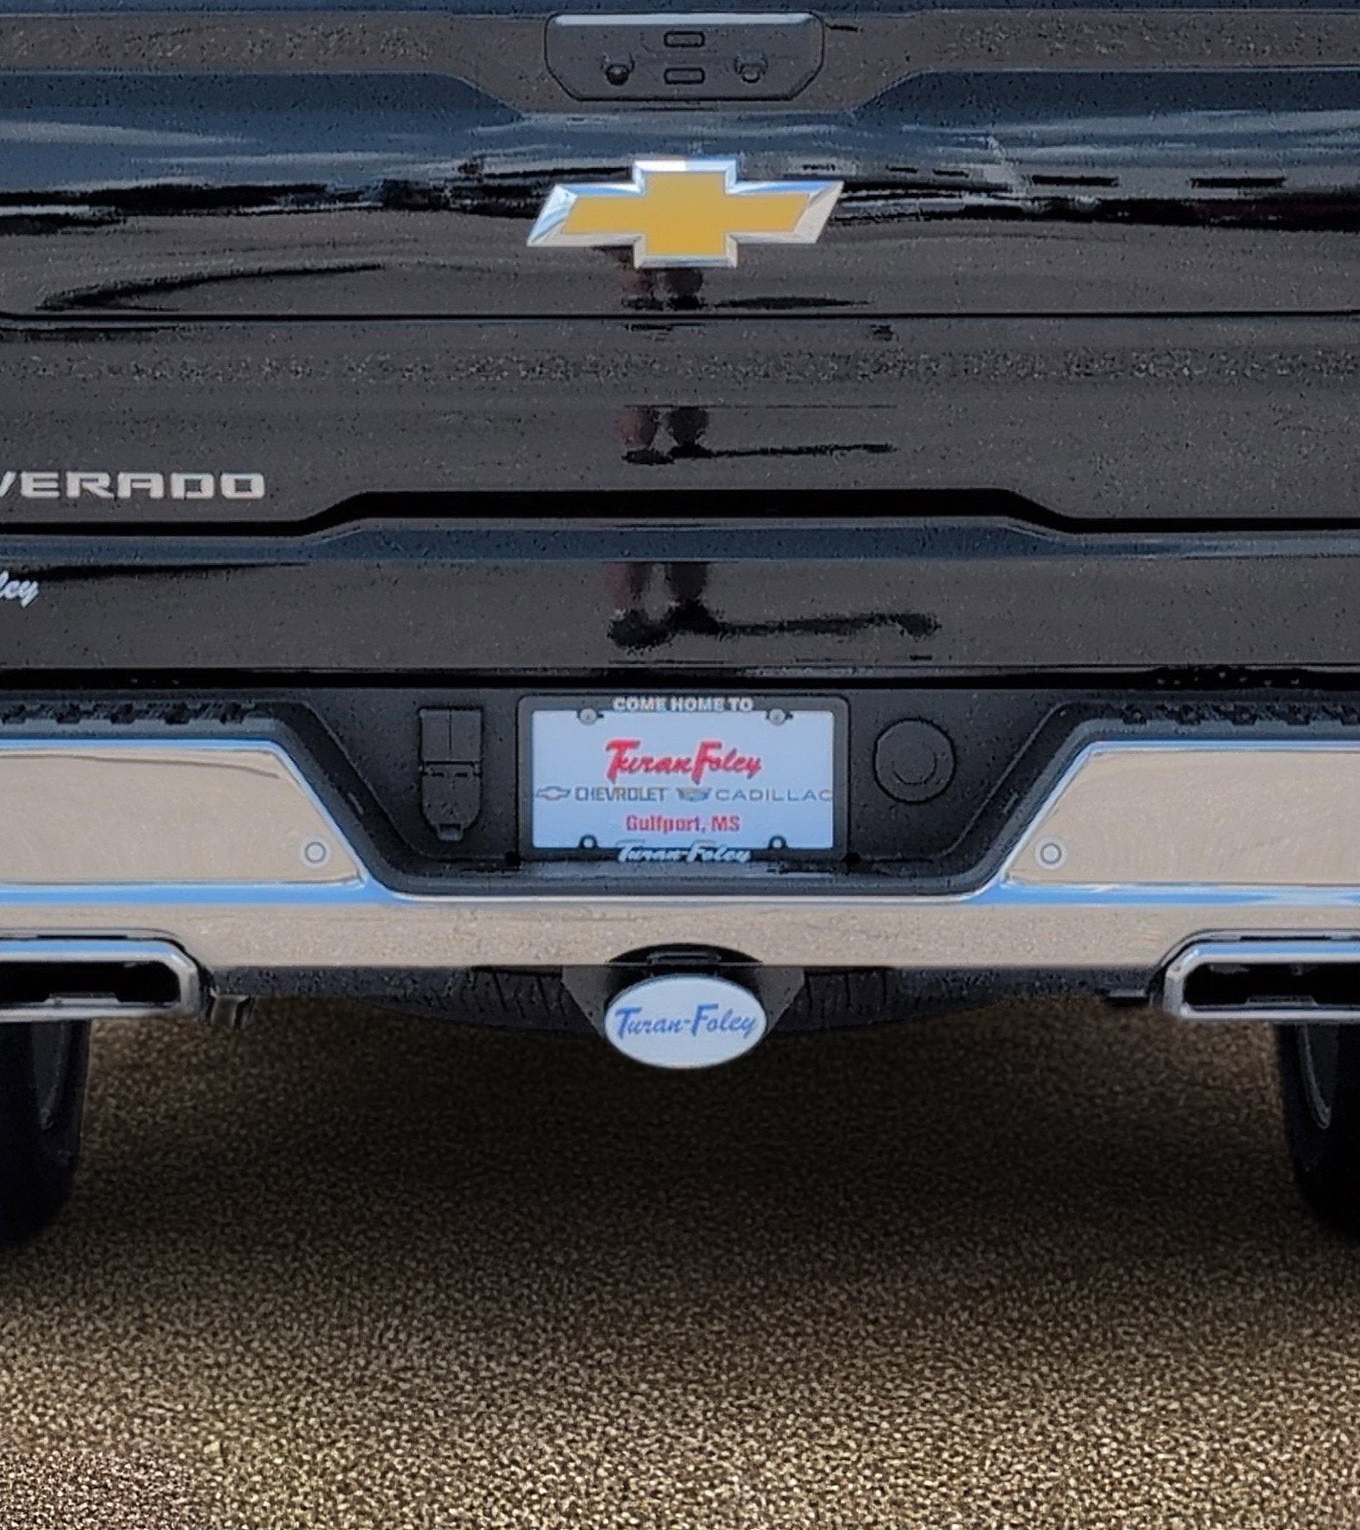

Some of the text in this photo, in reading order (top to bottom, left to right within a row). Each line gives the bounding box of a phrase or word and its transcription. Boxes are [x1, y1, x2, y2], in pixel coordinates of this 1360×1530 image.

[612, 695, 755, 712] COME HOME TO
[574, 786, 834, 802] CHEVROLET CADILLAC
[625, 814, 741, 834] Gulfport, MS
